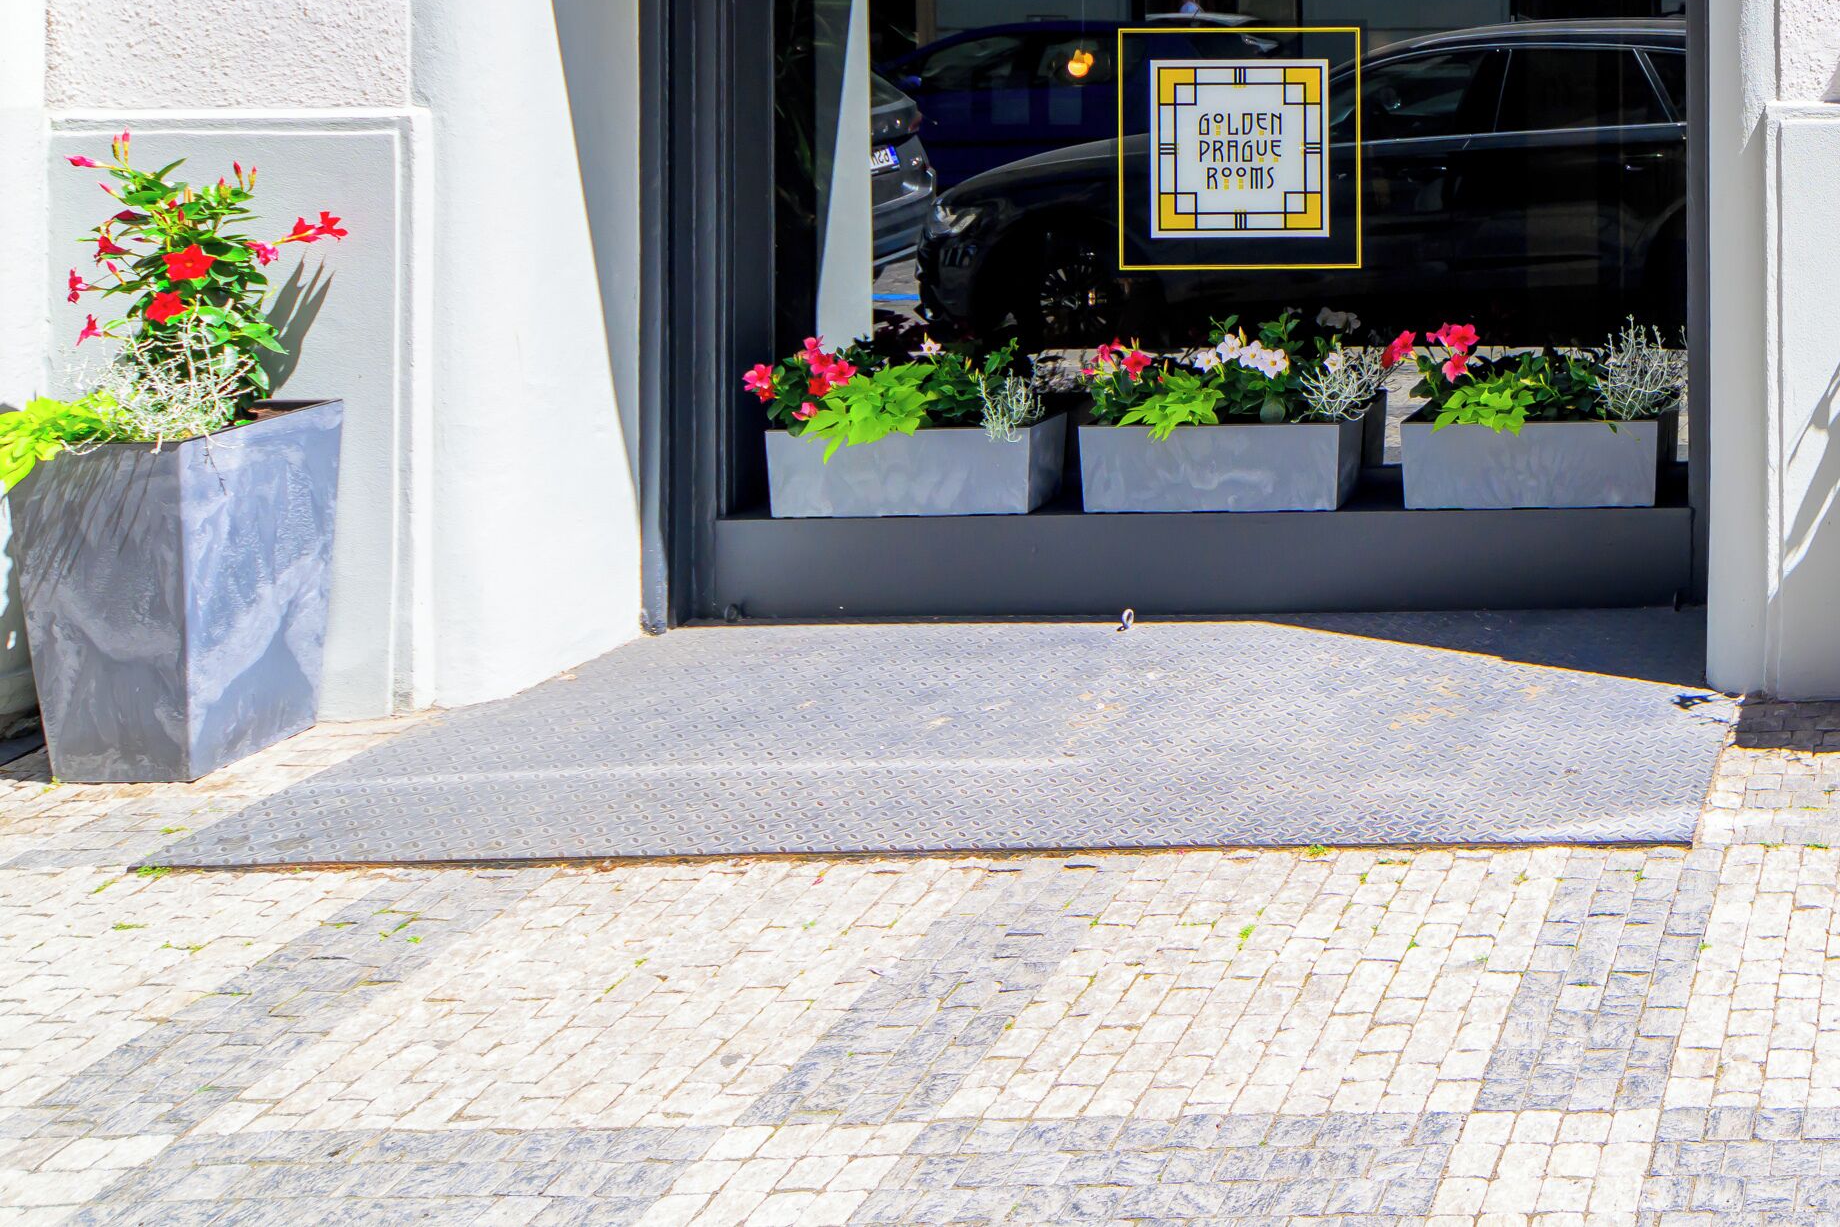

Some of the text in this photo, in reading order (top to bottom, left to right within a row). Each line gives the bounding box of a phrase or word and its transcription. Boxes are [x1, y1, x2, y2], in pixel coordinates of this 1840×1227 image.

[1198, 112, 1283, 137] GOLDEN
[1198, 139, 1283, 163] PRAGUE
[1206, 166, 1276, 191] ROOMS
